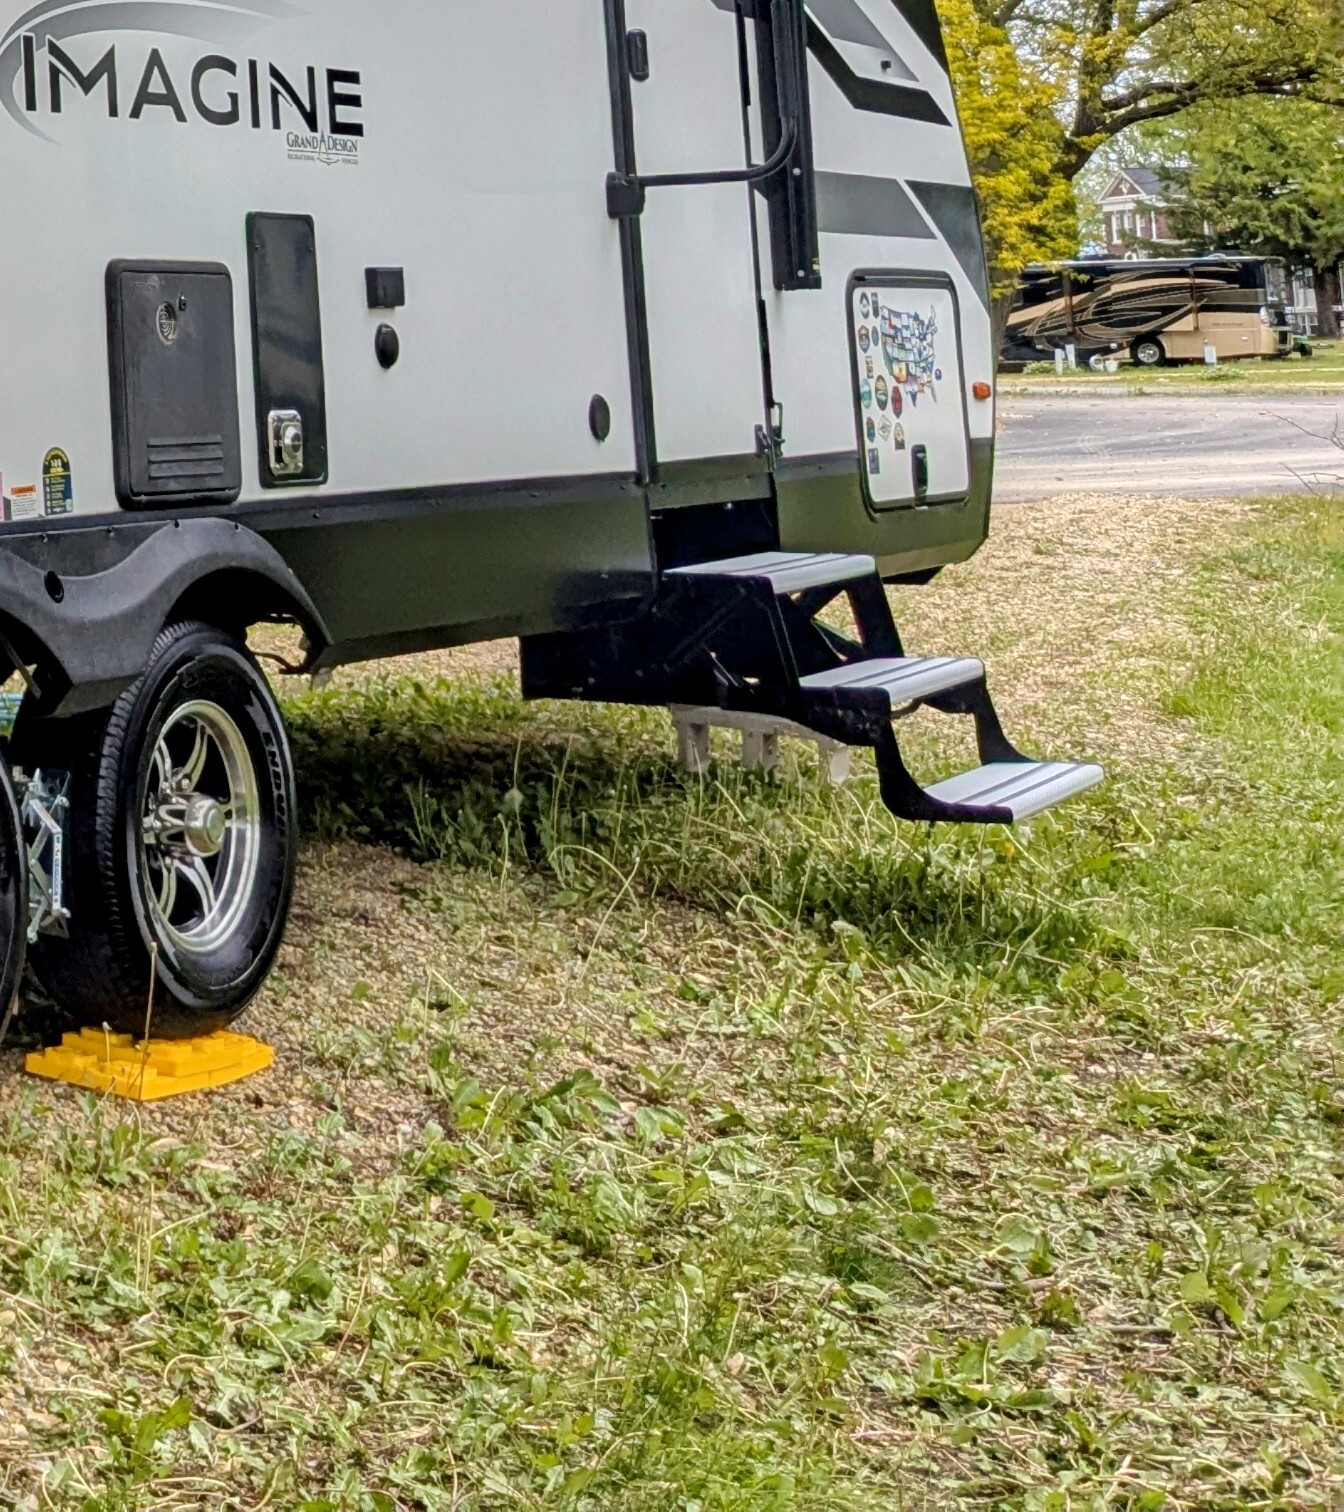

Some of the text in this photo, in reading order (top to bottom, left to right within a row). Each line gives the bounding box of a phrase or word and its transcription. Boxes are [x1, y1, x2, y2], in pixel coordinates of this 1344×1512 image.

[21, 34, 364, 137] IMAGINE
[286, 131, 358, 152] GRAND DESIGN
